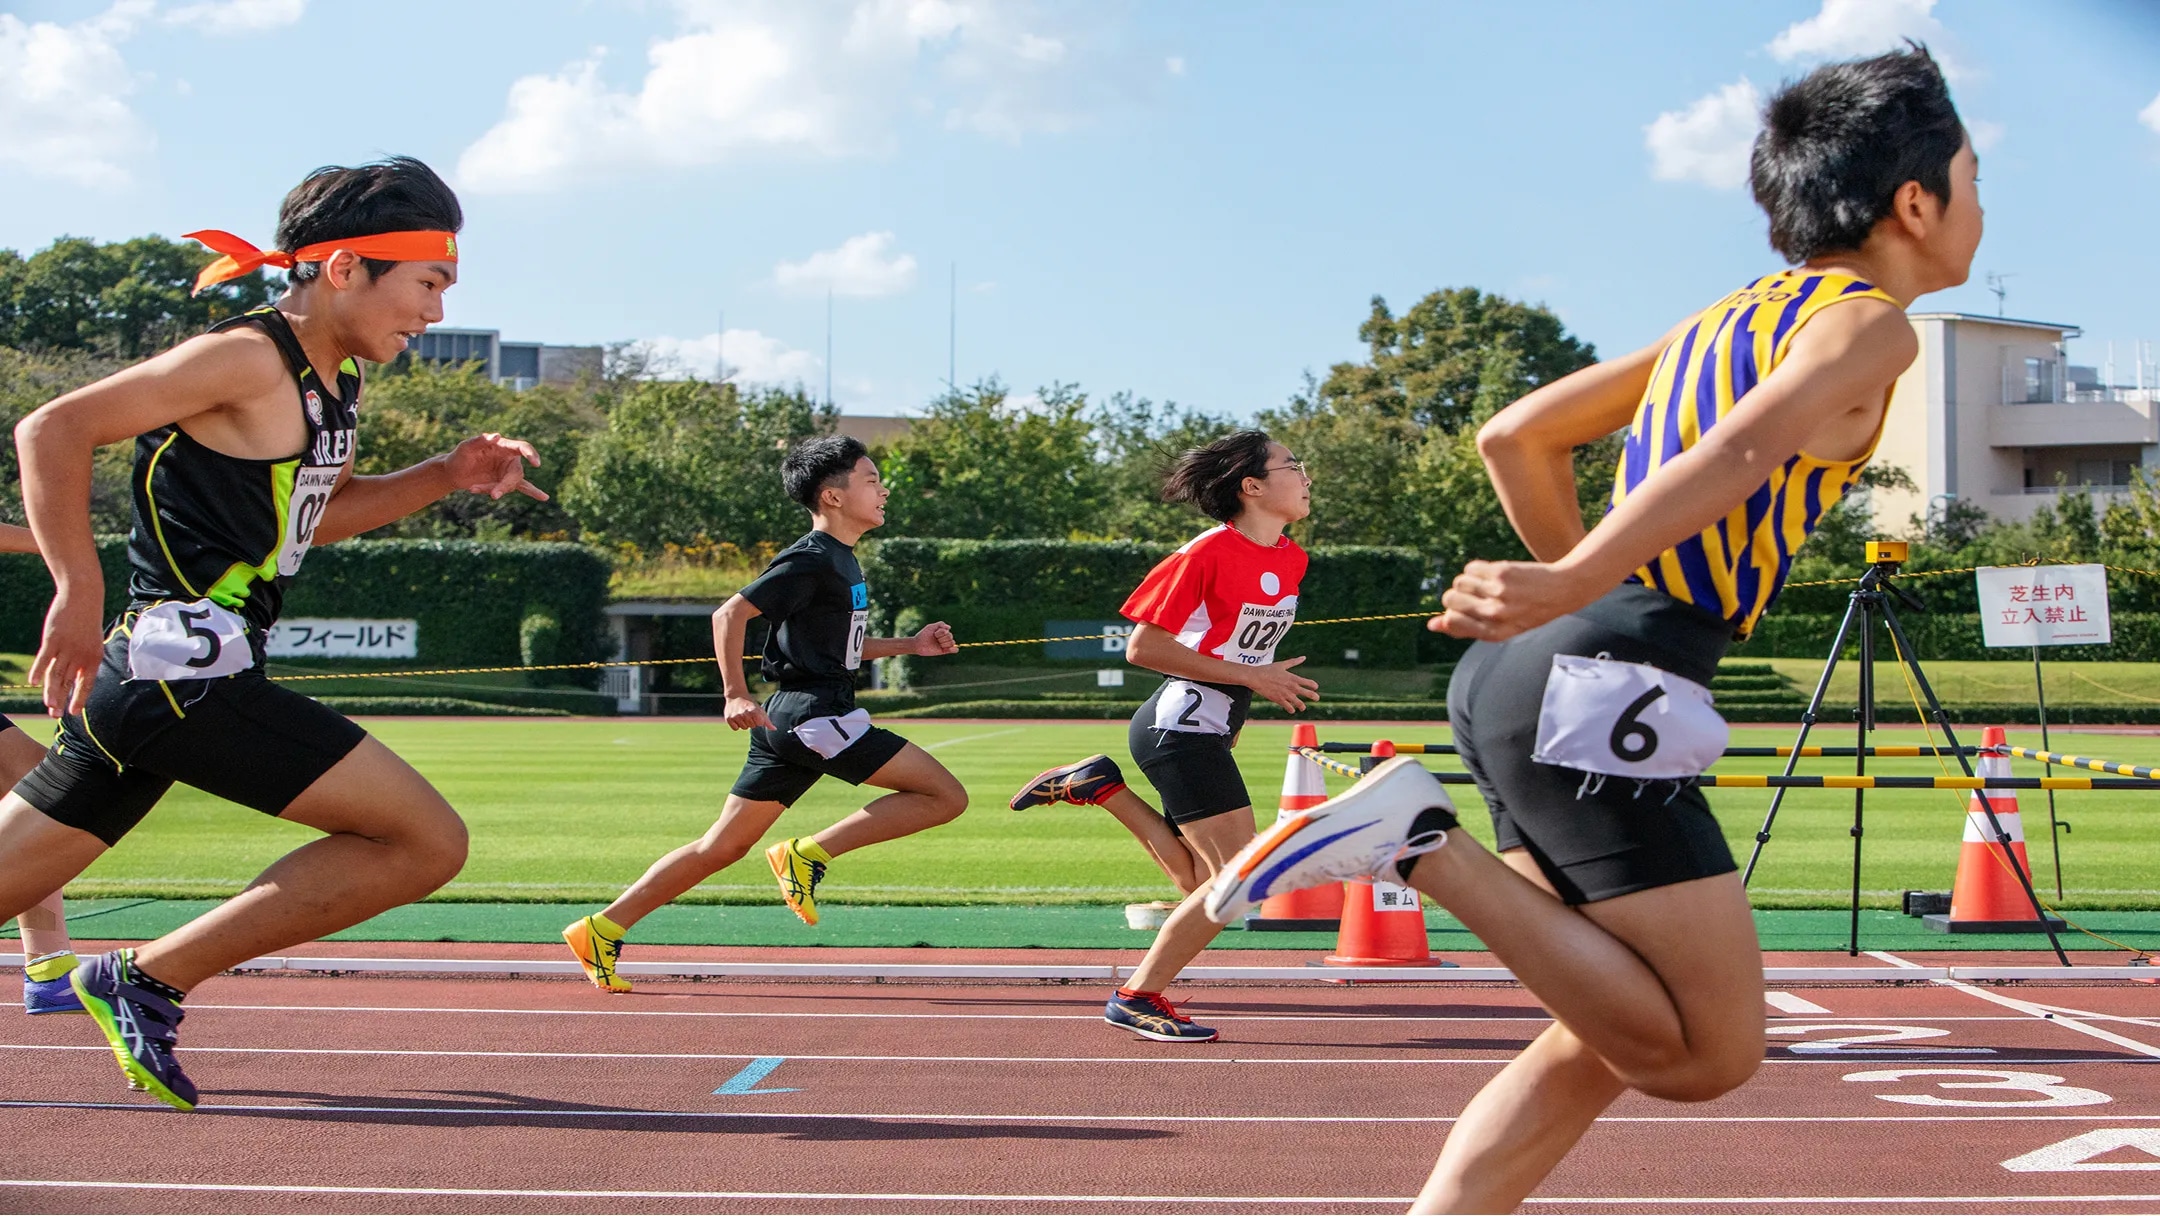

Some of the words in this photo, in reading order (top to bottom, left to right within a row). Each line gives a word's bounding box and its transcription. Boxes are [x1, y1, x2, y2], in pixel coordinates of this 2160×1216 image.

[296, 492, 326, 545] 02
[2009, 584, 2075, 603] 芝生内
[1243, 607, 1266, 617] DAWN
[2001, 605, 2088, 625] 立入禁止
[178, 608, 222, 669] 5
[289, 625, 406, 648] フィールド
[1238, 620, 1288, 651] 020
[1178, 688, 1202, 727] 2
[1610, 684, 1667, 762] 6
[1765, 1024, 1997, 1054] 2
[1842, 1068, 2114, 1108] 3
